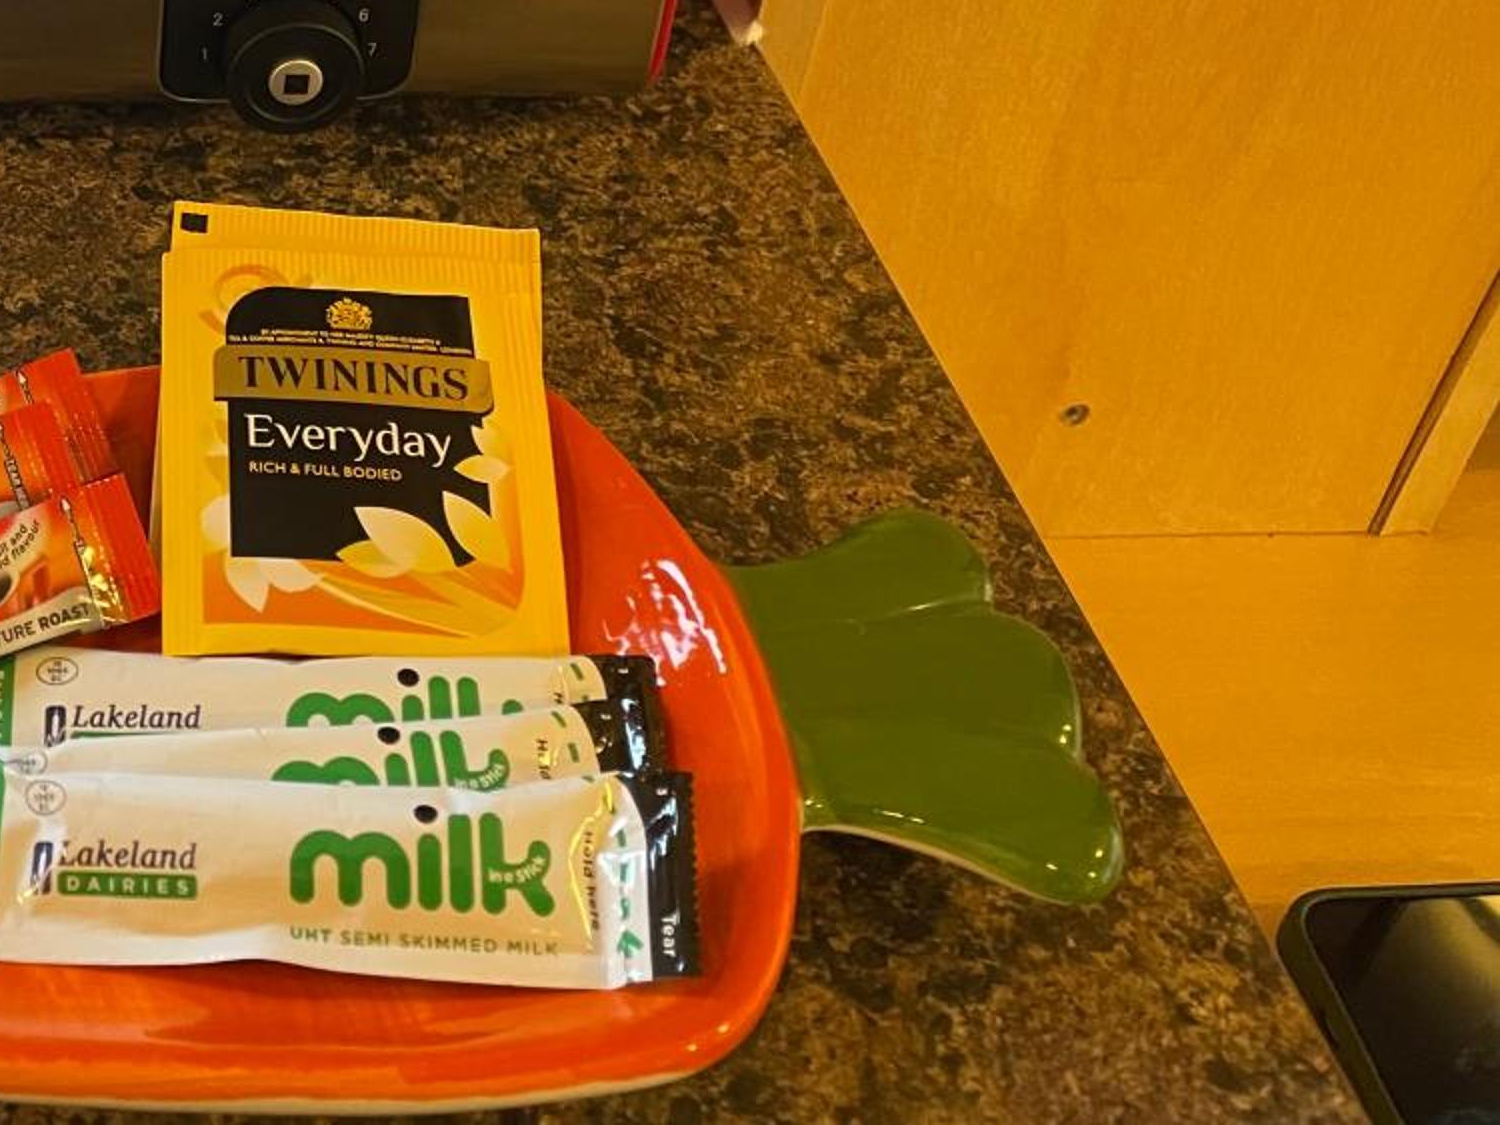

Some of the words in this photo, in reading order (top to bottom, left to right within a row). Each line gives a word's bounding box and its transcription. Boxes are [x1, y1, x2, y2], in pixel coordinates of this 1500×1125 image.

[201, 48, 208, 60] 1
[213, 12, 223, 26] 2
[358, 8, 370, 23] 6
[367, 43, 378, 57] 7
[238, 356, 468, 400] TWININGS
[244, 413, 451, 468] Everyday
[249, 460, 287, 474] RICH
[289, 463, 301, 475] &
[304, 463, 341, 477] FULL
[343, 466, 403, 481] BODIED
[8, 519, 41, 559] flavour
[9, 523, 28, 546] and
[38, 602, 92, 631] ROAST
[73, 704, 202, 730] Lakeland
[58, 839, 197, 870] Lakeland
[289, 804, 555, 917] milk
[583, 830, 596, 879] Hold
[66, 877, 190, 895] DAIRIES
[586, 885, 600, 932] here
[290, 927, 332, 943] UHT
[340, 929, 390, 947] SEMI
[399, 933, 498, 953] SKIMMED
[506, 939, 558, 956] MILK
[661, 907, 682, 958] Tear
